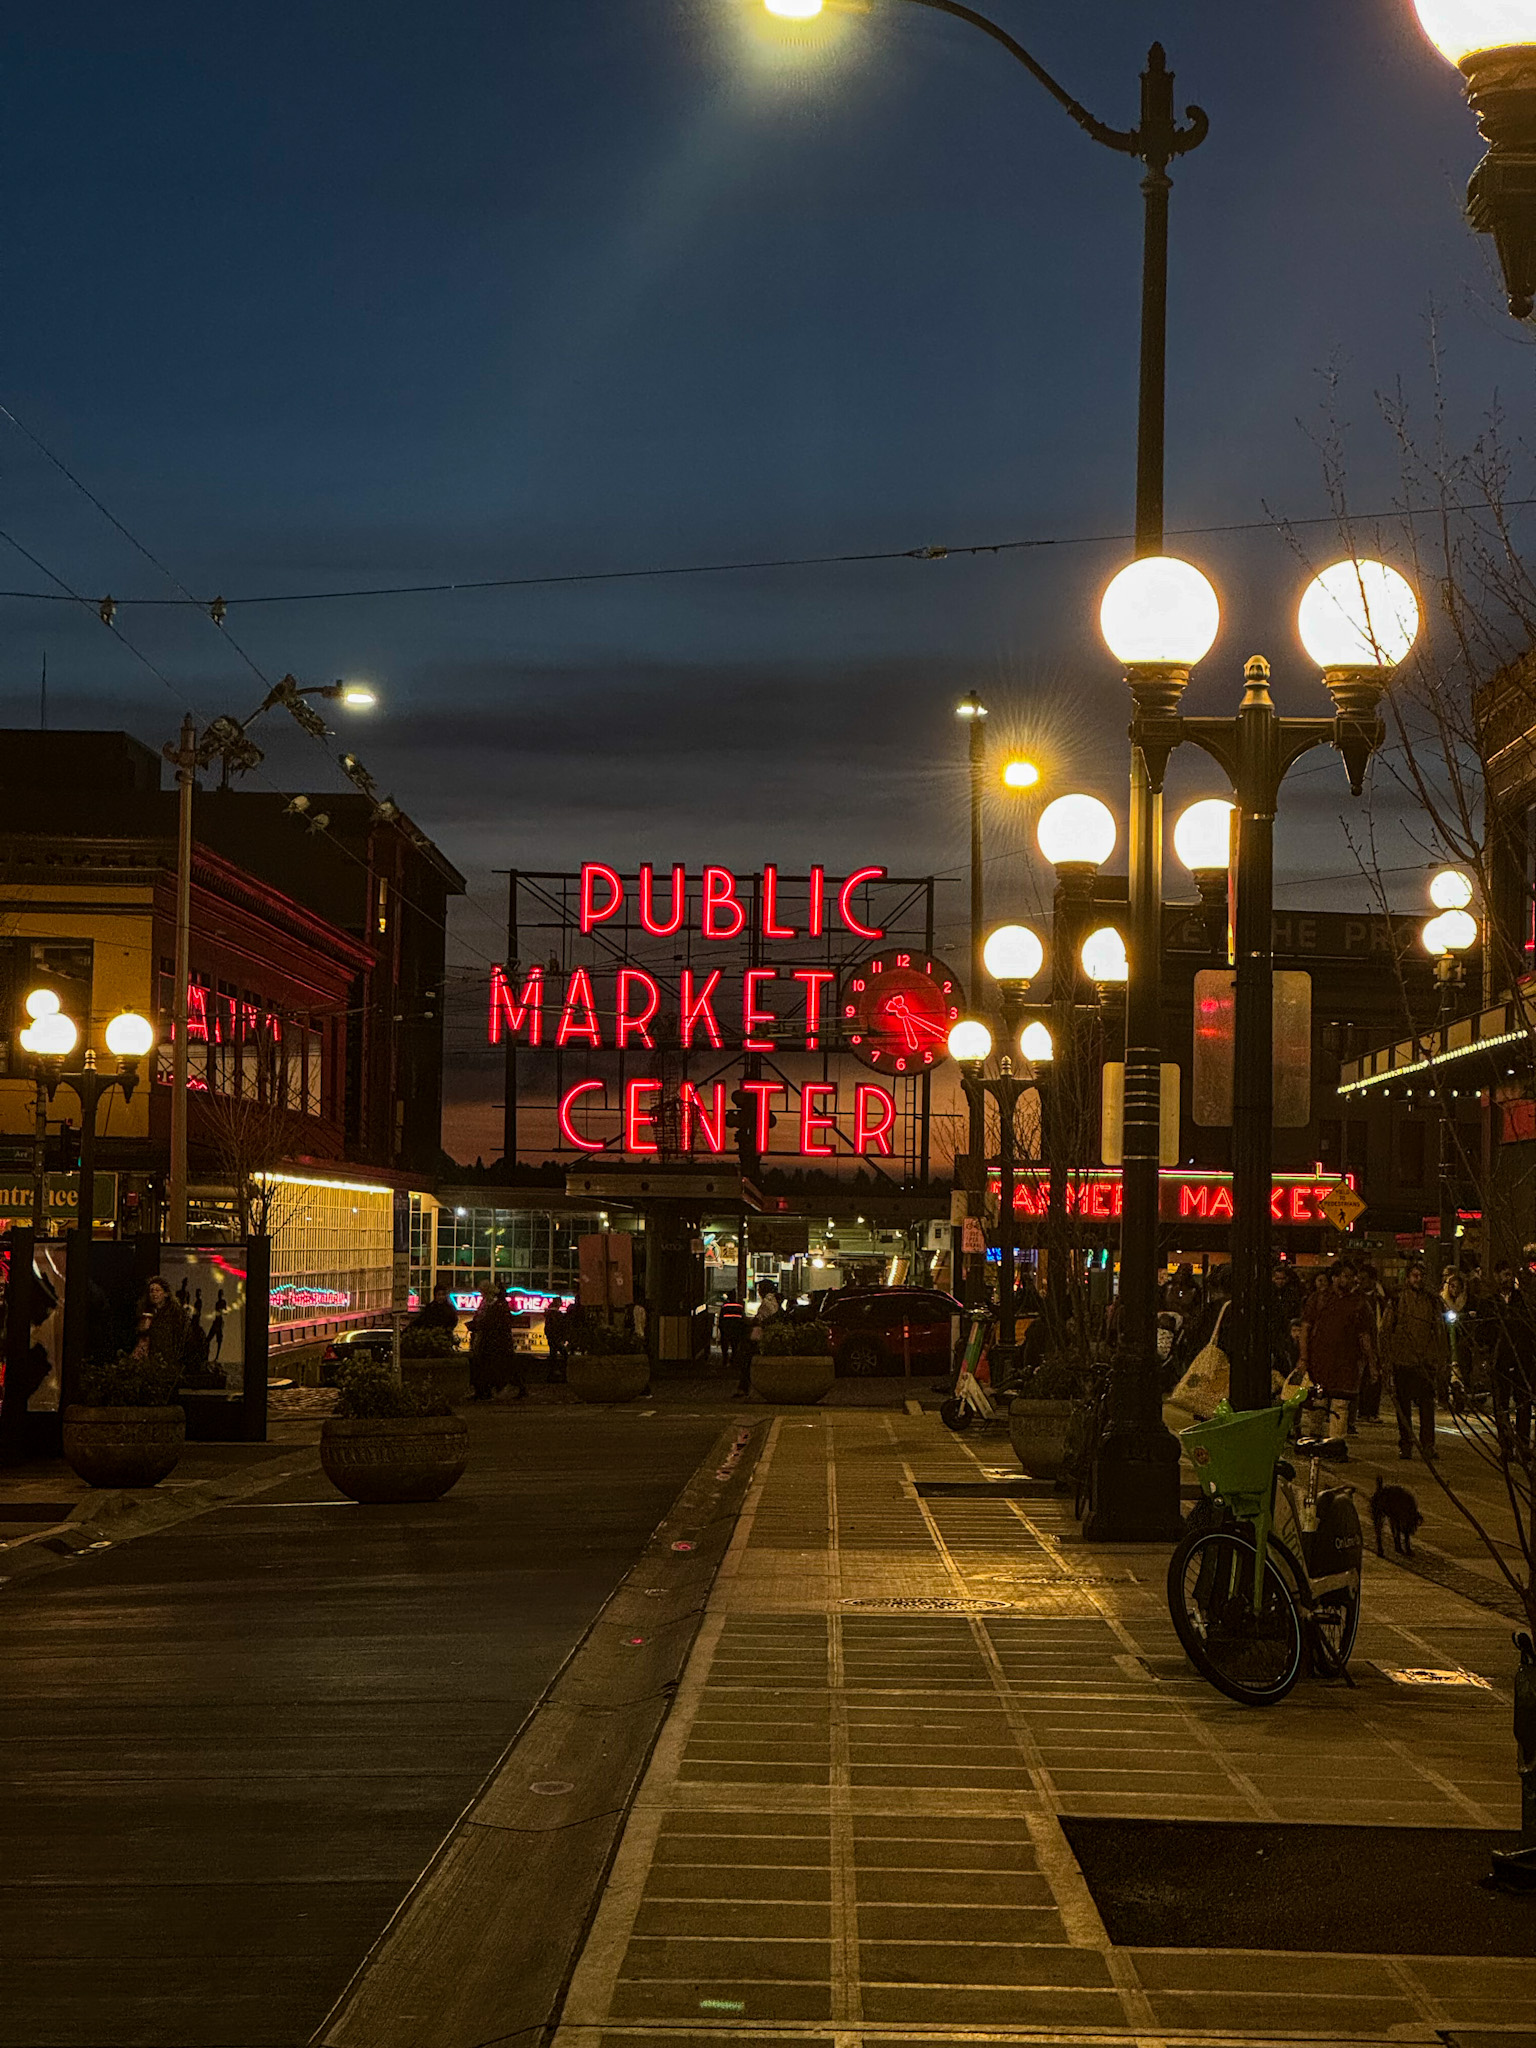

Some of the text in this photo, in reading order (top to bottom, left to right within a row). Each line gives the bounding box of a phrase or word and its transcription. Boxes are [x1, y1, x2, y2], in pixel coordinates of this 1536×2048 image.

[579, 861, 888, 940] PUBLIC
[871, 960, 883, 974] 11
[896, 953, 911, 968] 12
[926, 961, 932, 975] 1
[852, 979, 865, 992] 10
[943, 981, 953, 994] 2
[488, 963, 837, 1051] MARKET
[845, 1004, 856, 1018] 9
[949, 1006, 959, 1020] 3
[871, 1050, 881, 1063] 7
[924, 1051, 934, 1064] 5
[895, 1057, 906, 1071] 6
[557, 1078, 897, 1157] CENTER
[0, 1186, 80, 1207] ntrace
[1180, 1184, 1335, 1219] MAKET
